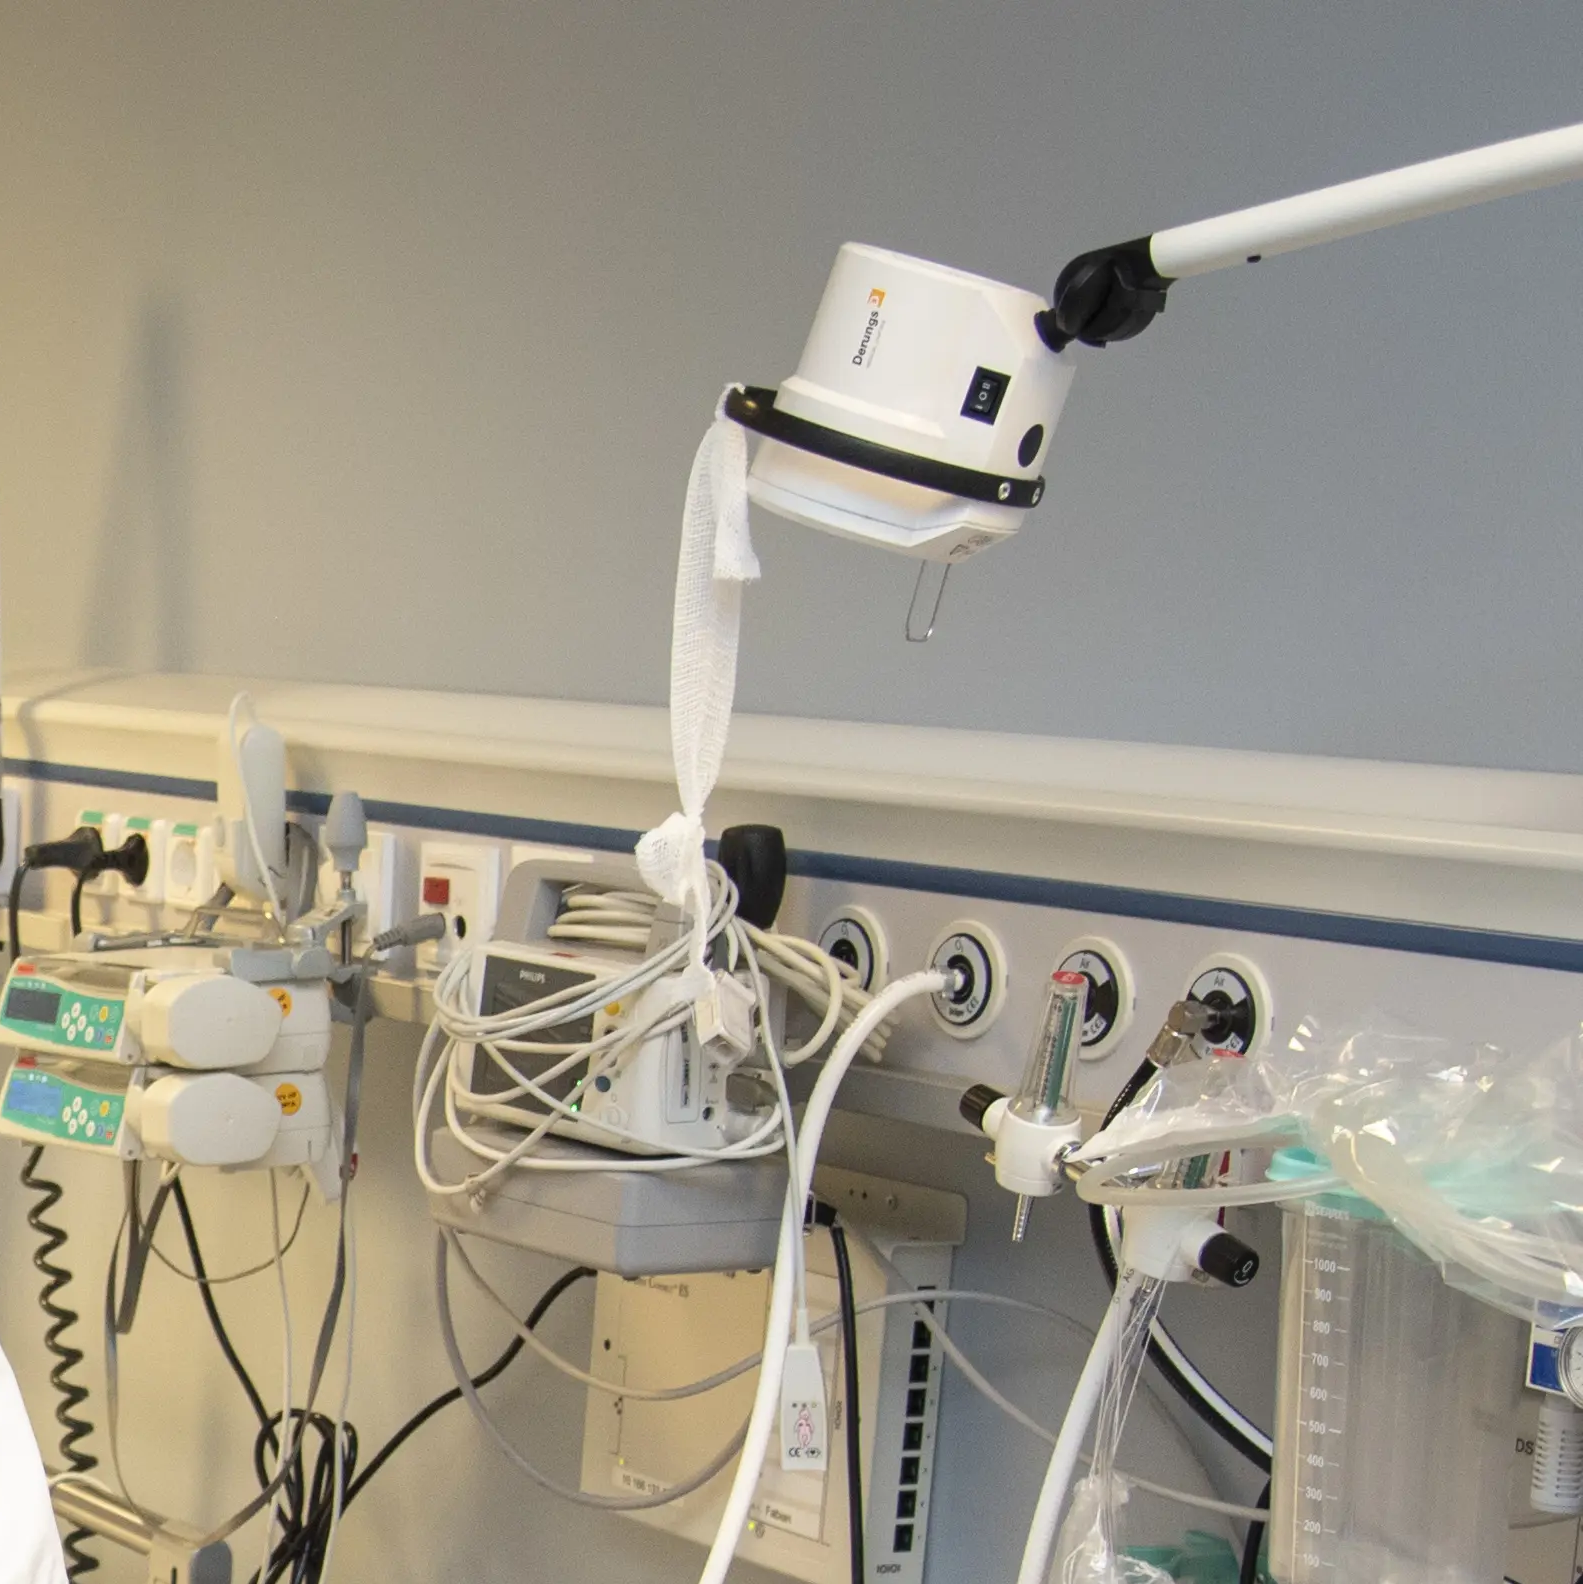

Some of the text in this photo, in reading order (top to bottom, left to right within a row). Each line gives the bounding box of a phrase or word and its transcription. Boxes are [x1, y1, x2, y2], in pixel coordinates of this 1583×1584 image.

[852, 311, 879, 366] Derungs
[519, 970, 546, 984] PHILIPS
[1213, 975, 1226, 987] Air
[1314, 1257, 1336, 1273] 1000
[1314, 1287, 1332, 1302] 900
[1313, 1320, 1330, 1335] 800
[1312, 1353, 1329, 1368] 700
[1310, 1386, 1327, 1401] 600
[1308, 1420, 1326, 1434] 500
[1306, 1453, 1324, 1468] 400
[1305, 1486, 1322, 1501] 300
[1304, 1519, 1321, 1534] 200
[1303, 1554, 1320, 1568] 100
